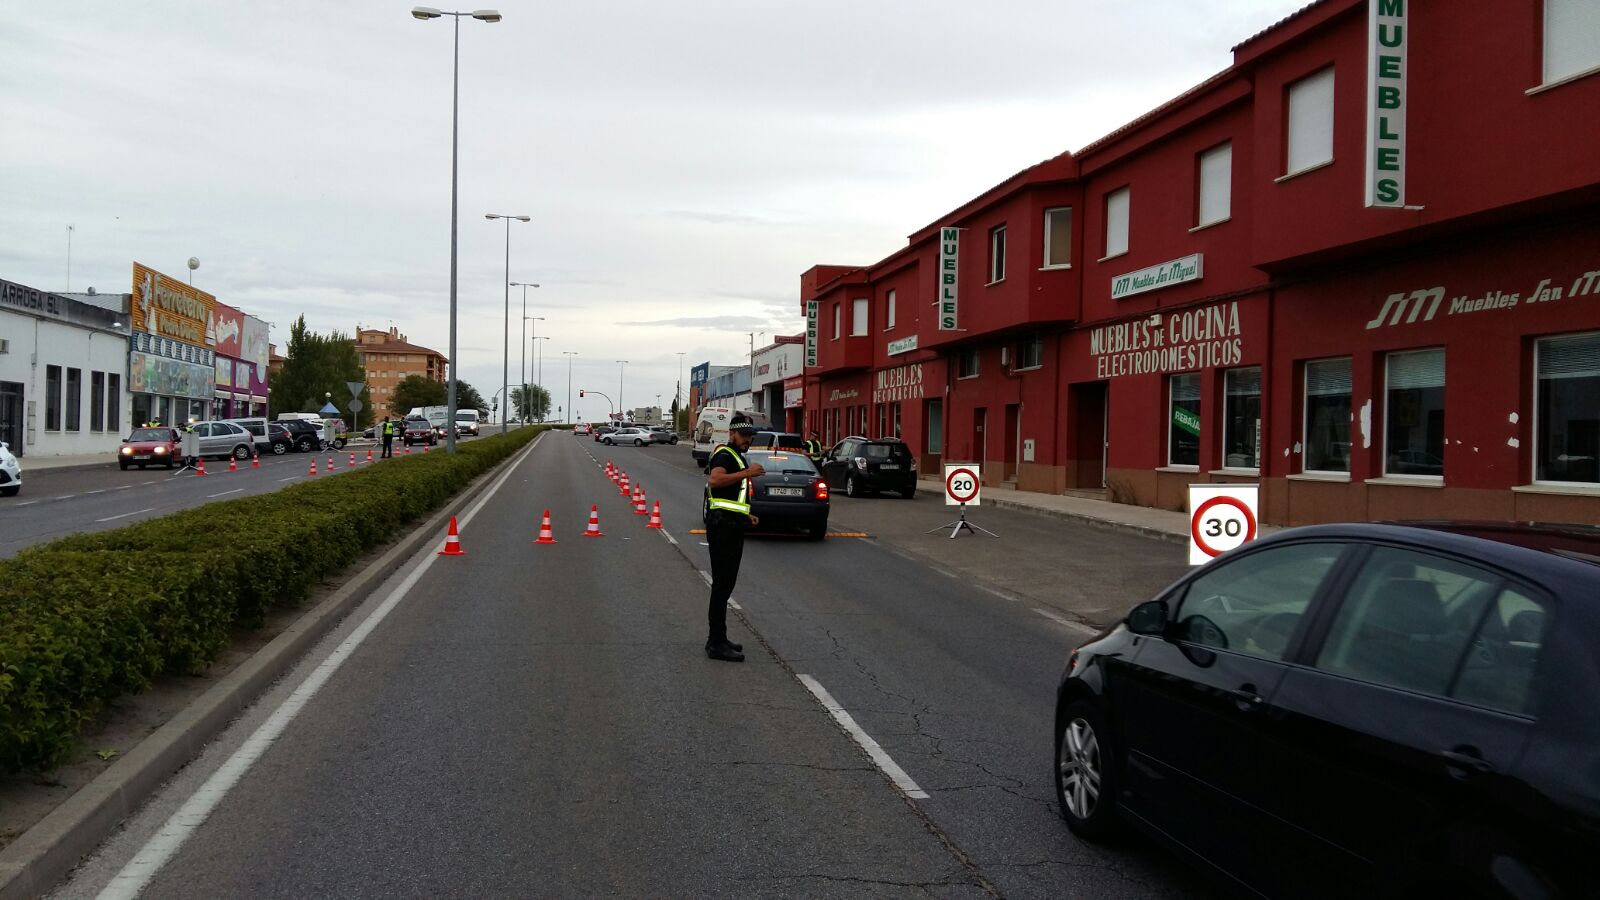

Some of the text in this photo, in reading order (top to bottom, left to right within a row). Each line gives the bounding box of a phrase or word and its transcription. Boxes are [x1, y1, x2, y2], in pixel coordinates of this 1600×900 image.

[1376, 0, 1402, 203] MUEBLES
[943, 229, 957, 329] MUEBLES
[1132, 273, 1155, 290] Muebles
[1156, 266, 1168, 284] San
[1169, 261, 1196, 282] Miguel
[0, 281, 60, 315] ARROSA SL
[1448, 290, 1521, 315] Muebles
[1526, 278, 1563, 304] San
[807, 301, 817, 366] MUEBLES
[1090, 301, 1241, 356] MUEBLES DE COCINA
[878, 363, 923, 390] MUEBLES
[1097, 338, 1242, 379] ELECTRODOMESTICOS
[953, 480, 973, 492] 20
[1205, 517, 1242, 538] 30
